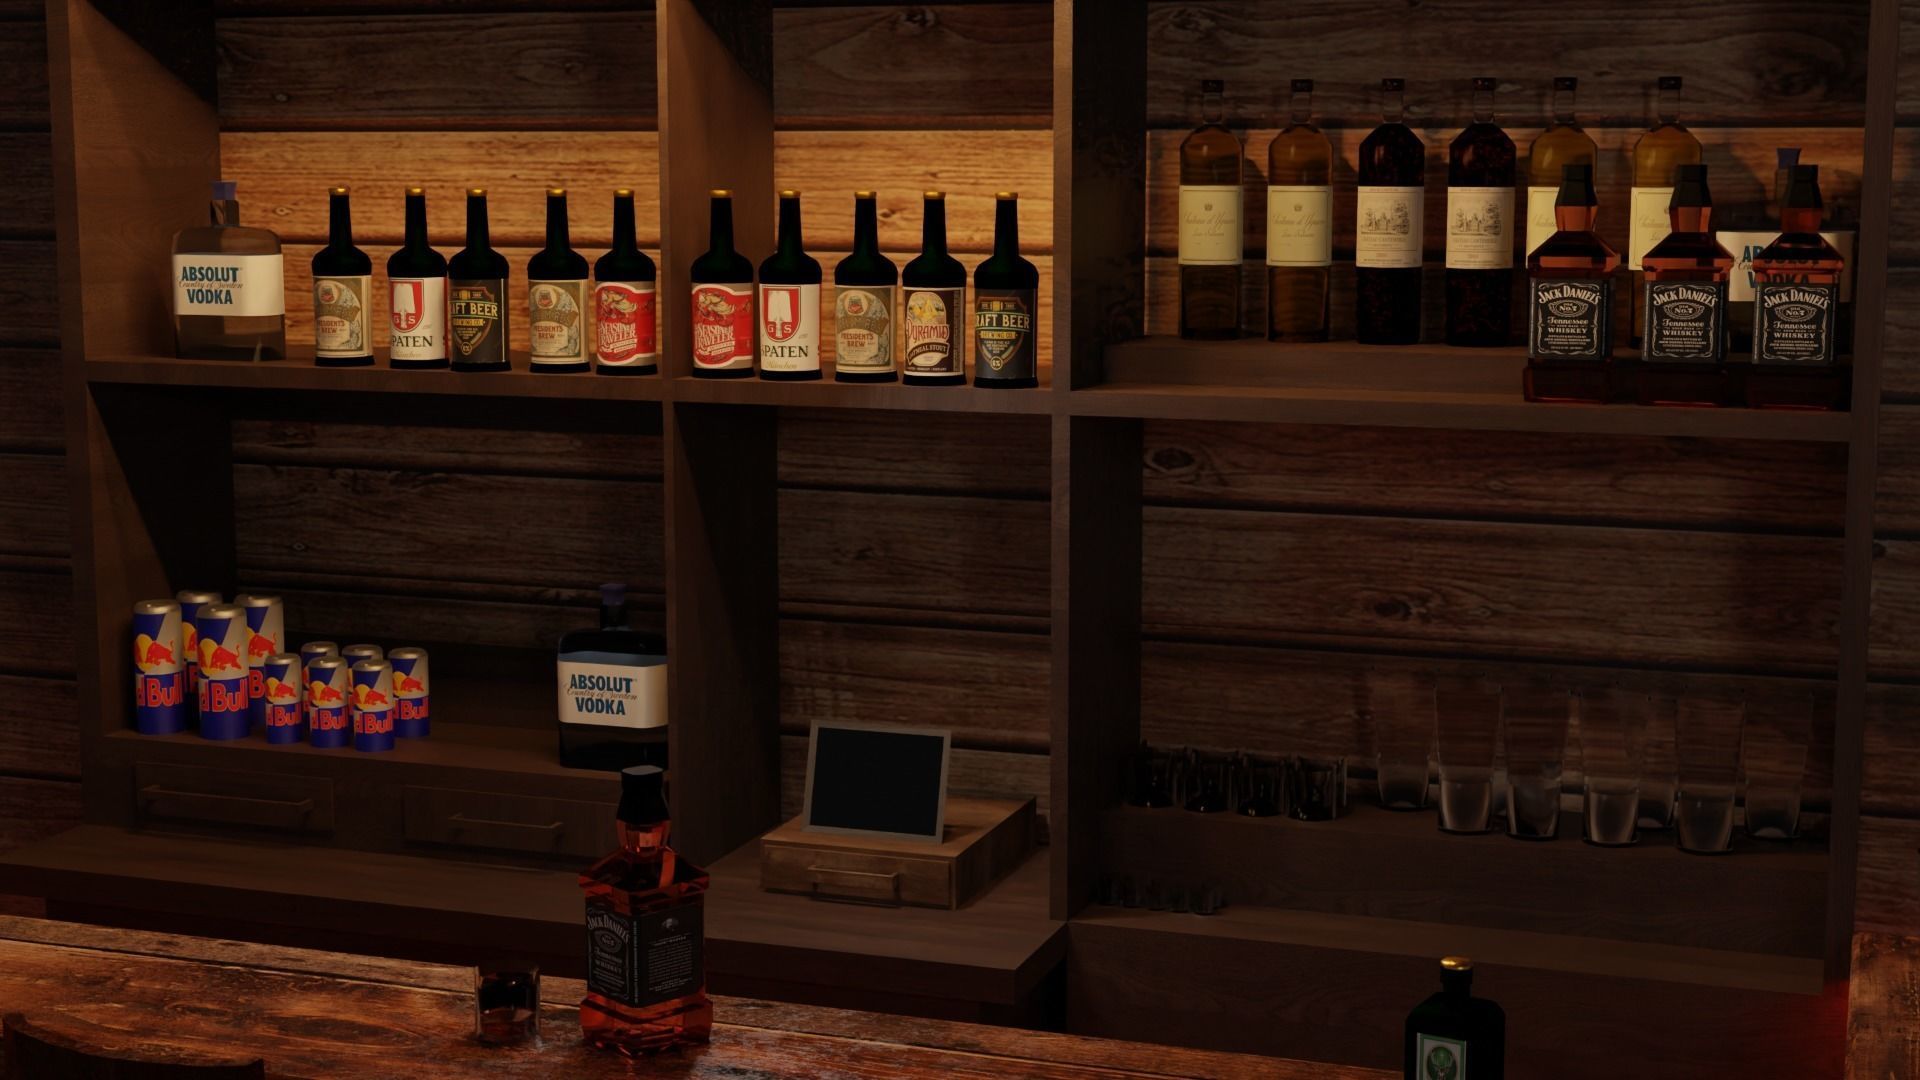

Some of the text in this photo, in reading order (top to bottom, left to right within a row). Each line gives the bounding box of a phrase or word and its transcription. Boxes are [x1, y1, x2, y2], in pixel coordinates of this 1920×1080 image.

[181, 266, 239, 282] ABSOLUT
[186, 288, 233, 305] VODKA
[1538, 287, 1562, 304] JACK
[1653, 290, 1678, 306] JACK
[1763, 291, 1789, 309] JACK
[470, 304, 499, 317] BEER
[407, 315, 416, 324] S
[1001, 315, 1030, 329] BEER
[767, 324, 792, 334] G S
[906, 318, 949, 343] PYRAMID
[147, 672, 183, 708] Bull
[570, 674, 633, 693] ABSOLUT
[211, 676, 249, 712] Bull
[575, 697, 626, 716] VODKA
